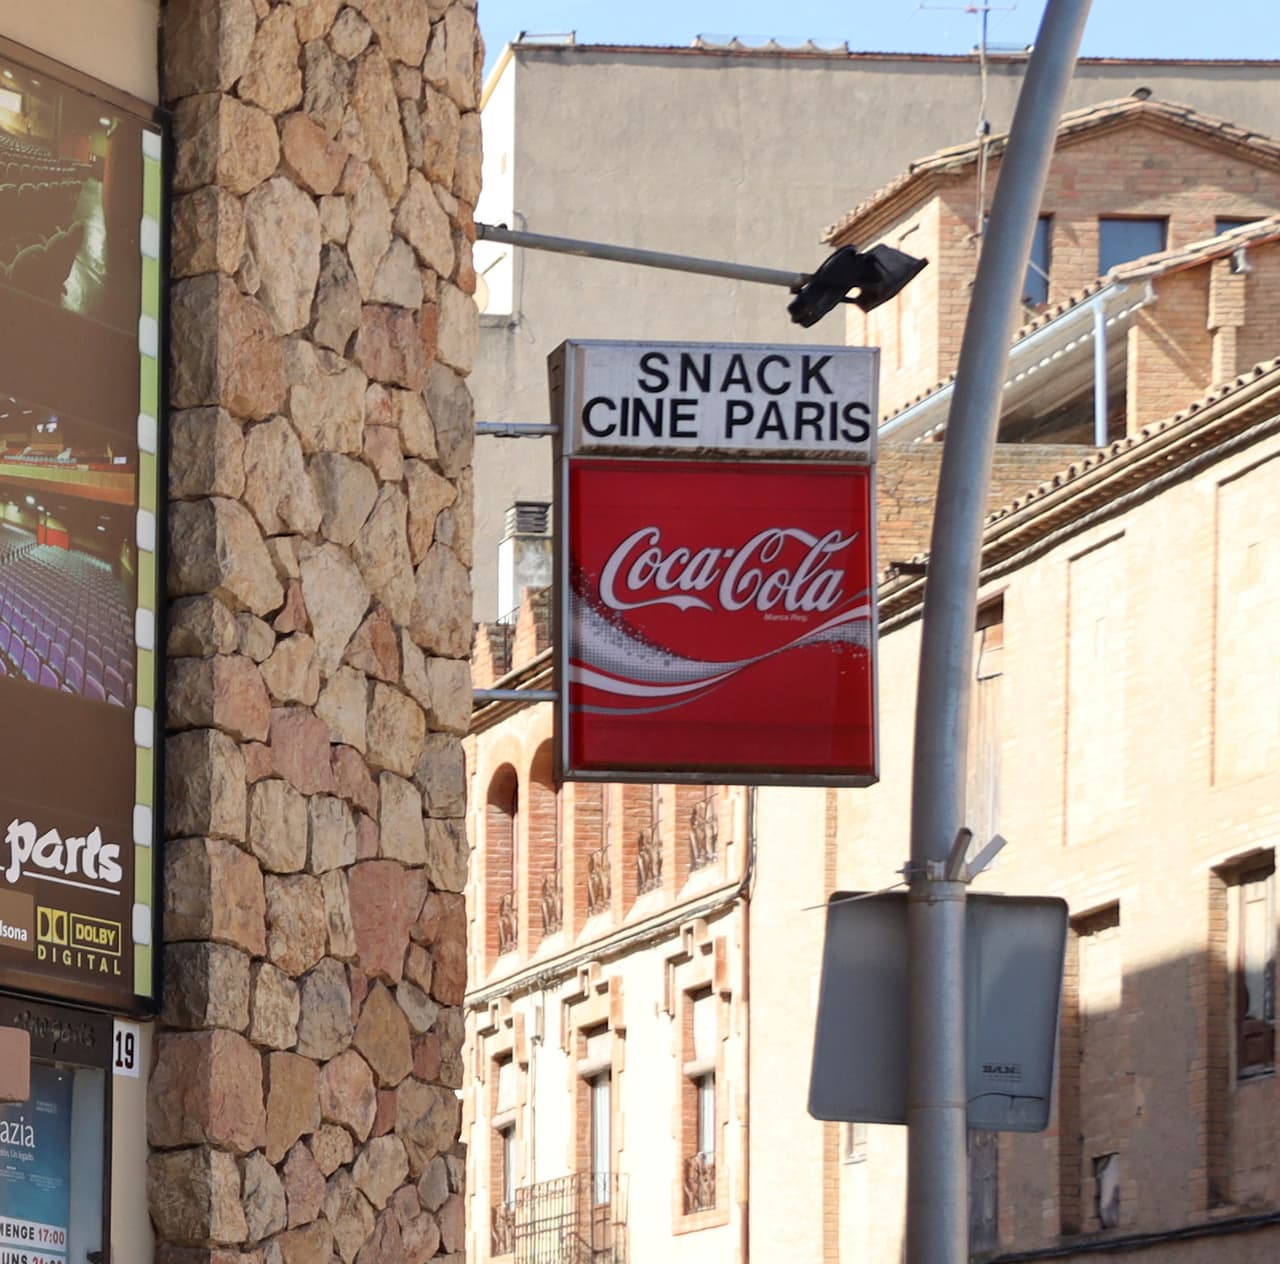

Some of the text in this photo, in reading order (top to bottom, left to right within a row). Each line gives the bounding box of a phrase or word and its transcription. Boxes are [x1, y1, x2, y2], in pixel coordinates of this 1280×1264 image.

[638, 351, 833, 395] SNACK
[581, 396, 871, 443] CINE PARIS
[599, 526, 859, 612] Coca-Cola
[75, 922, 117, 947] DOLBY
[37, 944, 122, 976] DIGITAL
[114, 1029, 136, 1070] 19
[38, 1228, 65, 1245] 17:00
